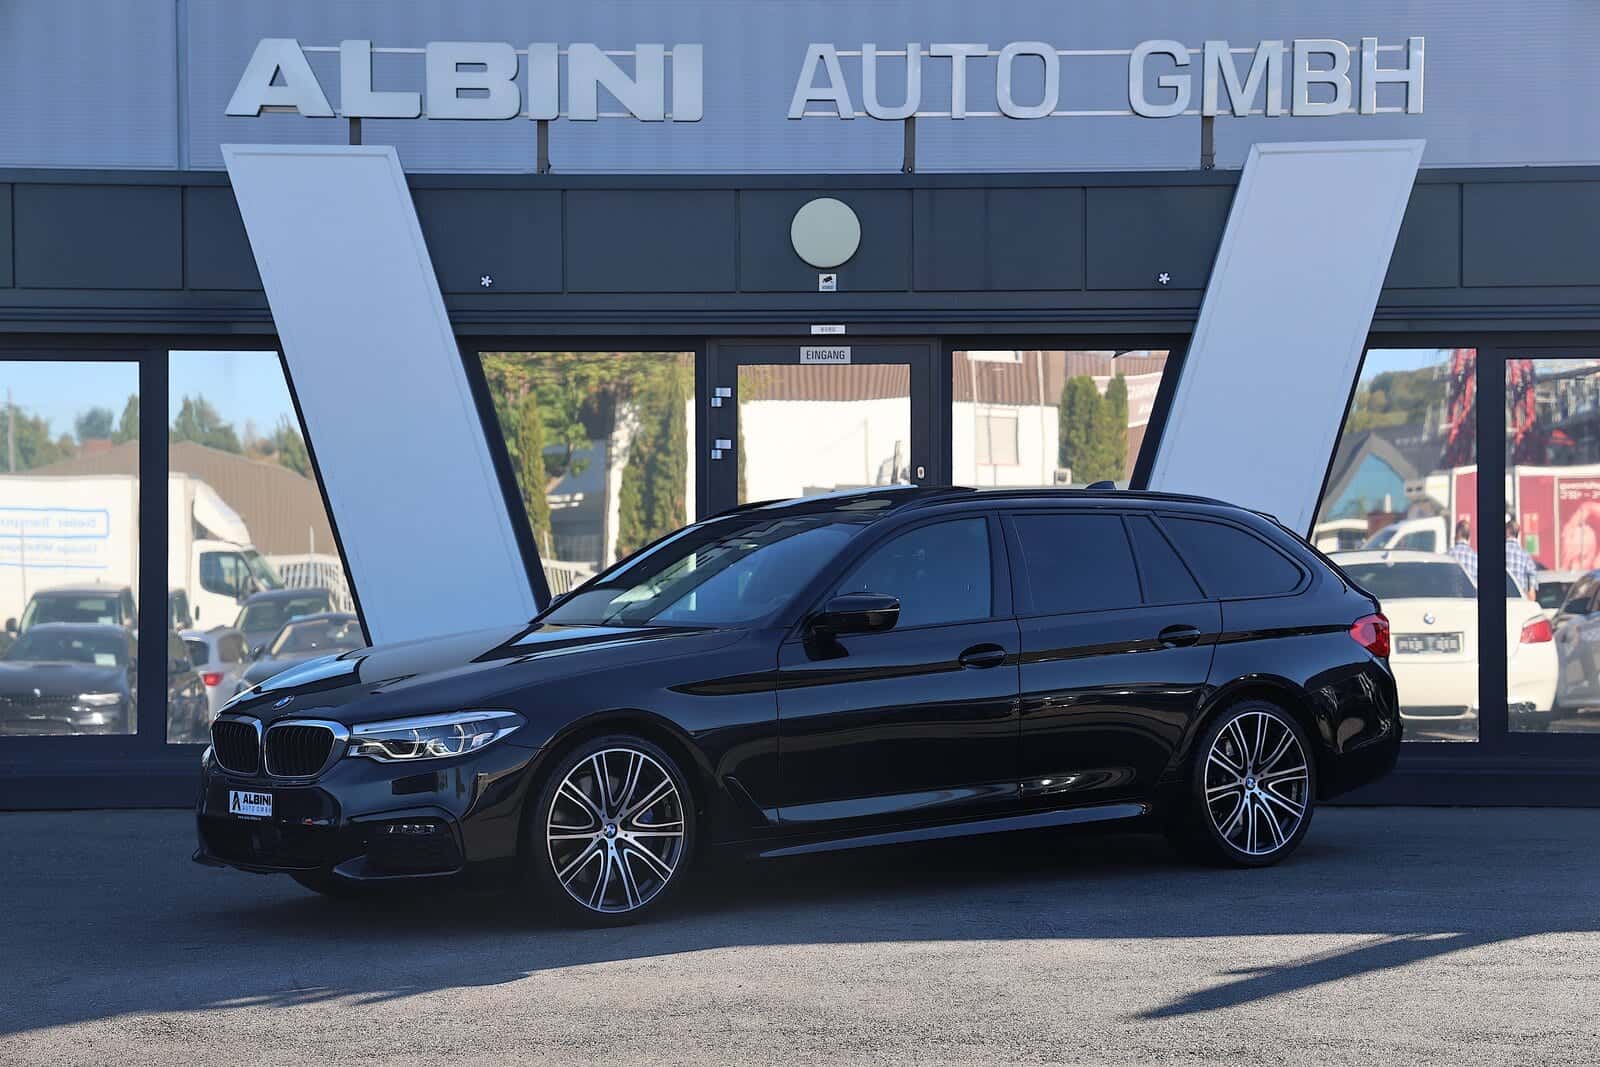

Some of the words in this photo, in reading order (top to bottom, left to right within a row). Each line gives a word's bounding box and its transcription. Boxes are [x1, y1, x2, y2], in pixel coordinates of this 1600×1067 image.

[224, 38, 704, 122] ALBINI
[787, 40, 1060, 121] AUTO
[1128, 36, 1426, 119] GMBH
[806, 350, 846, 360] EINGANG
[242, 793, 272, 806] ALBINI
